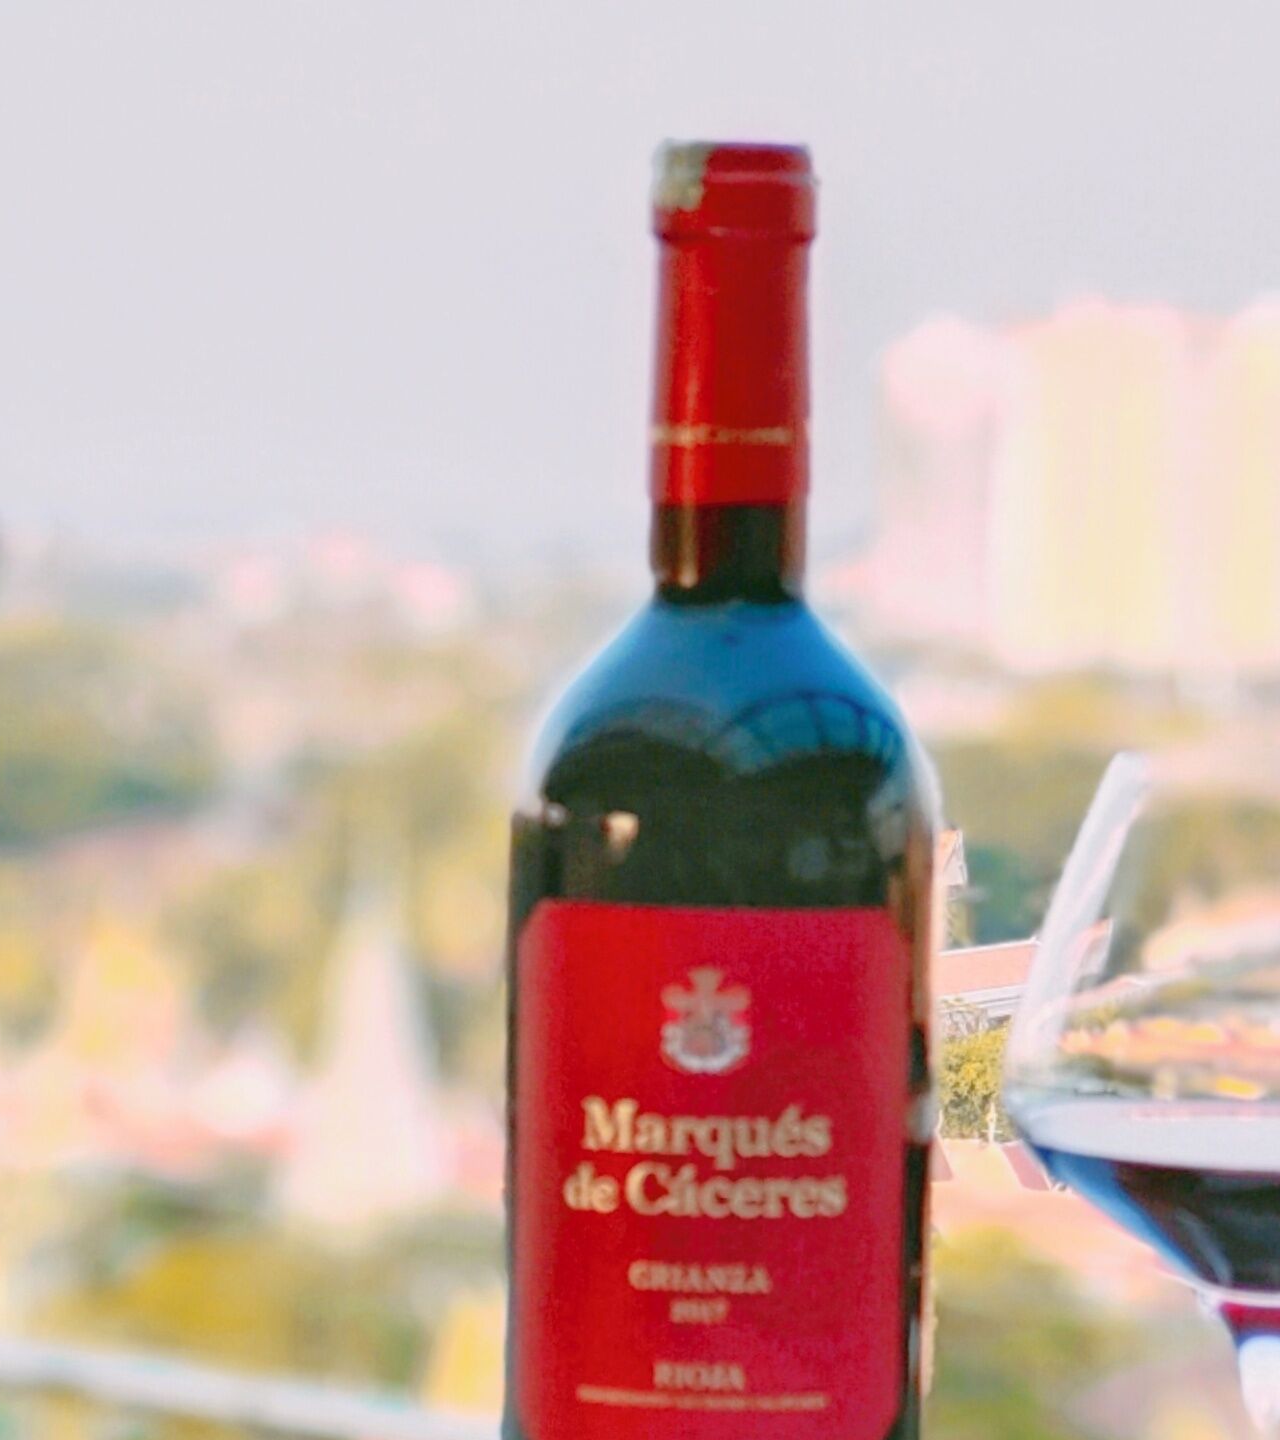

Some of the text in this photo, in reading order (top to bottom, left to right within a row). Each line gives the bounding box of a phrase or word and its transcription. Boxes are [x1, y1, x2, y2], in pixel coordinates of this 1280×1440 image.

[581, 1096, 831, 1170] Marqués
[564, 1161, 847, 1218] de Cáceres
[628, 1260, 771, 1294] CRIANZA
